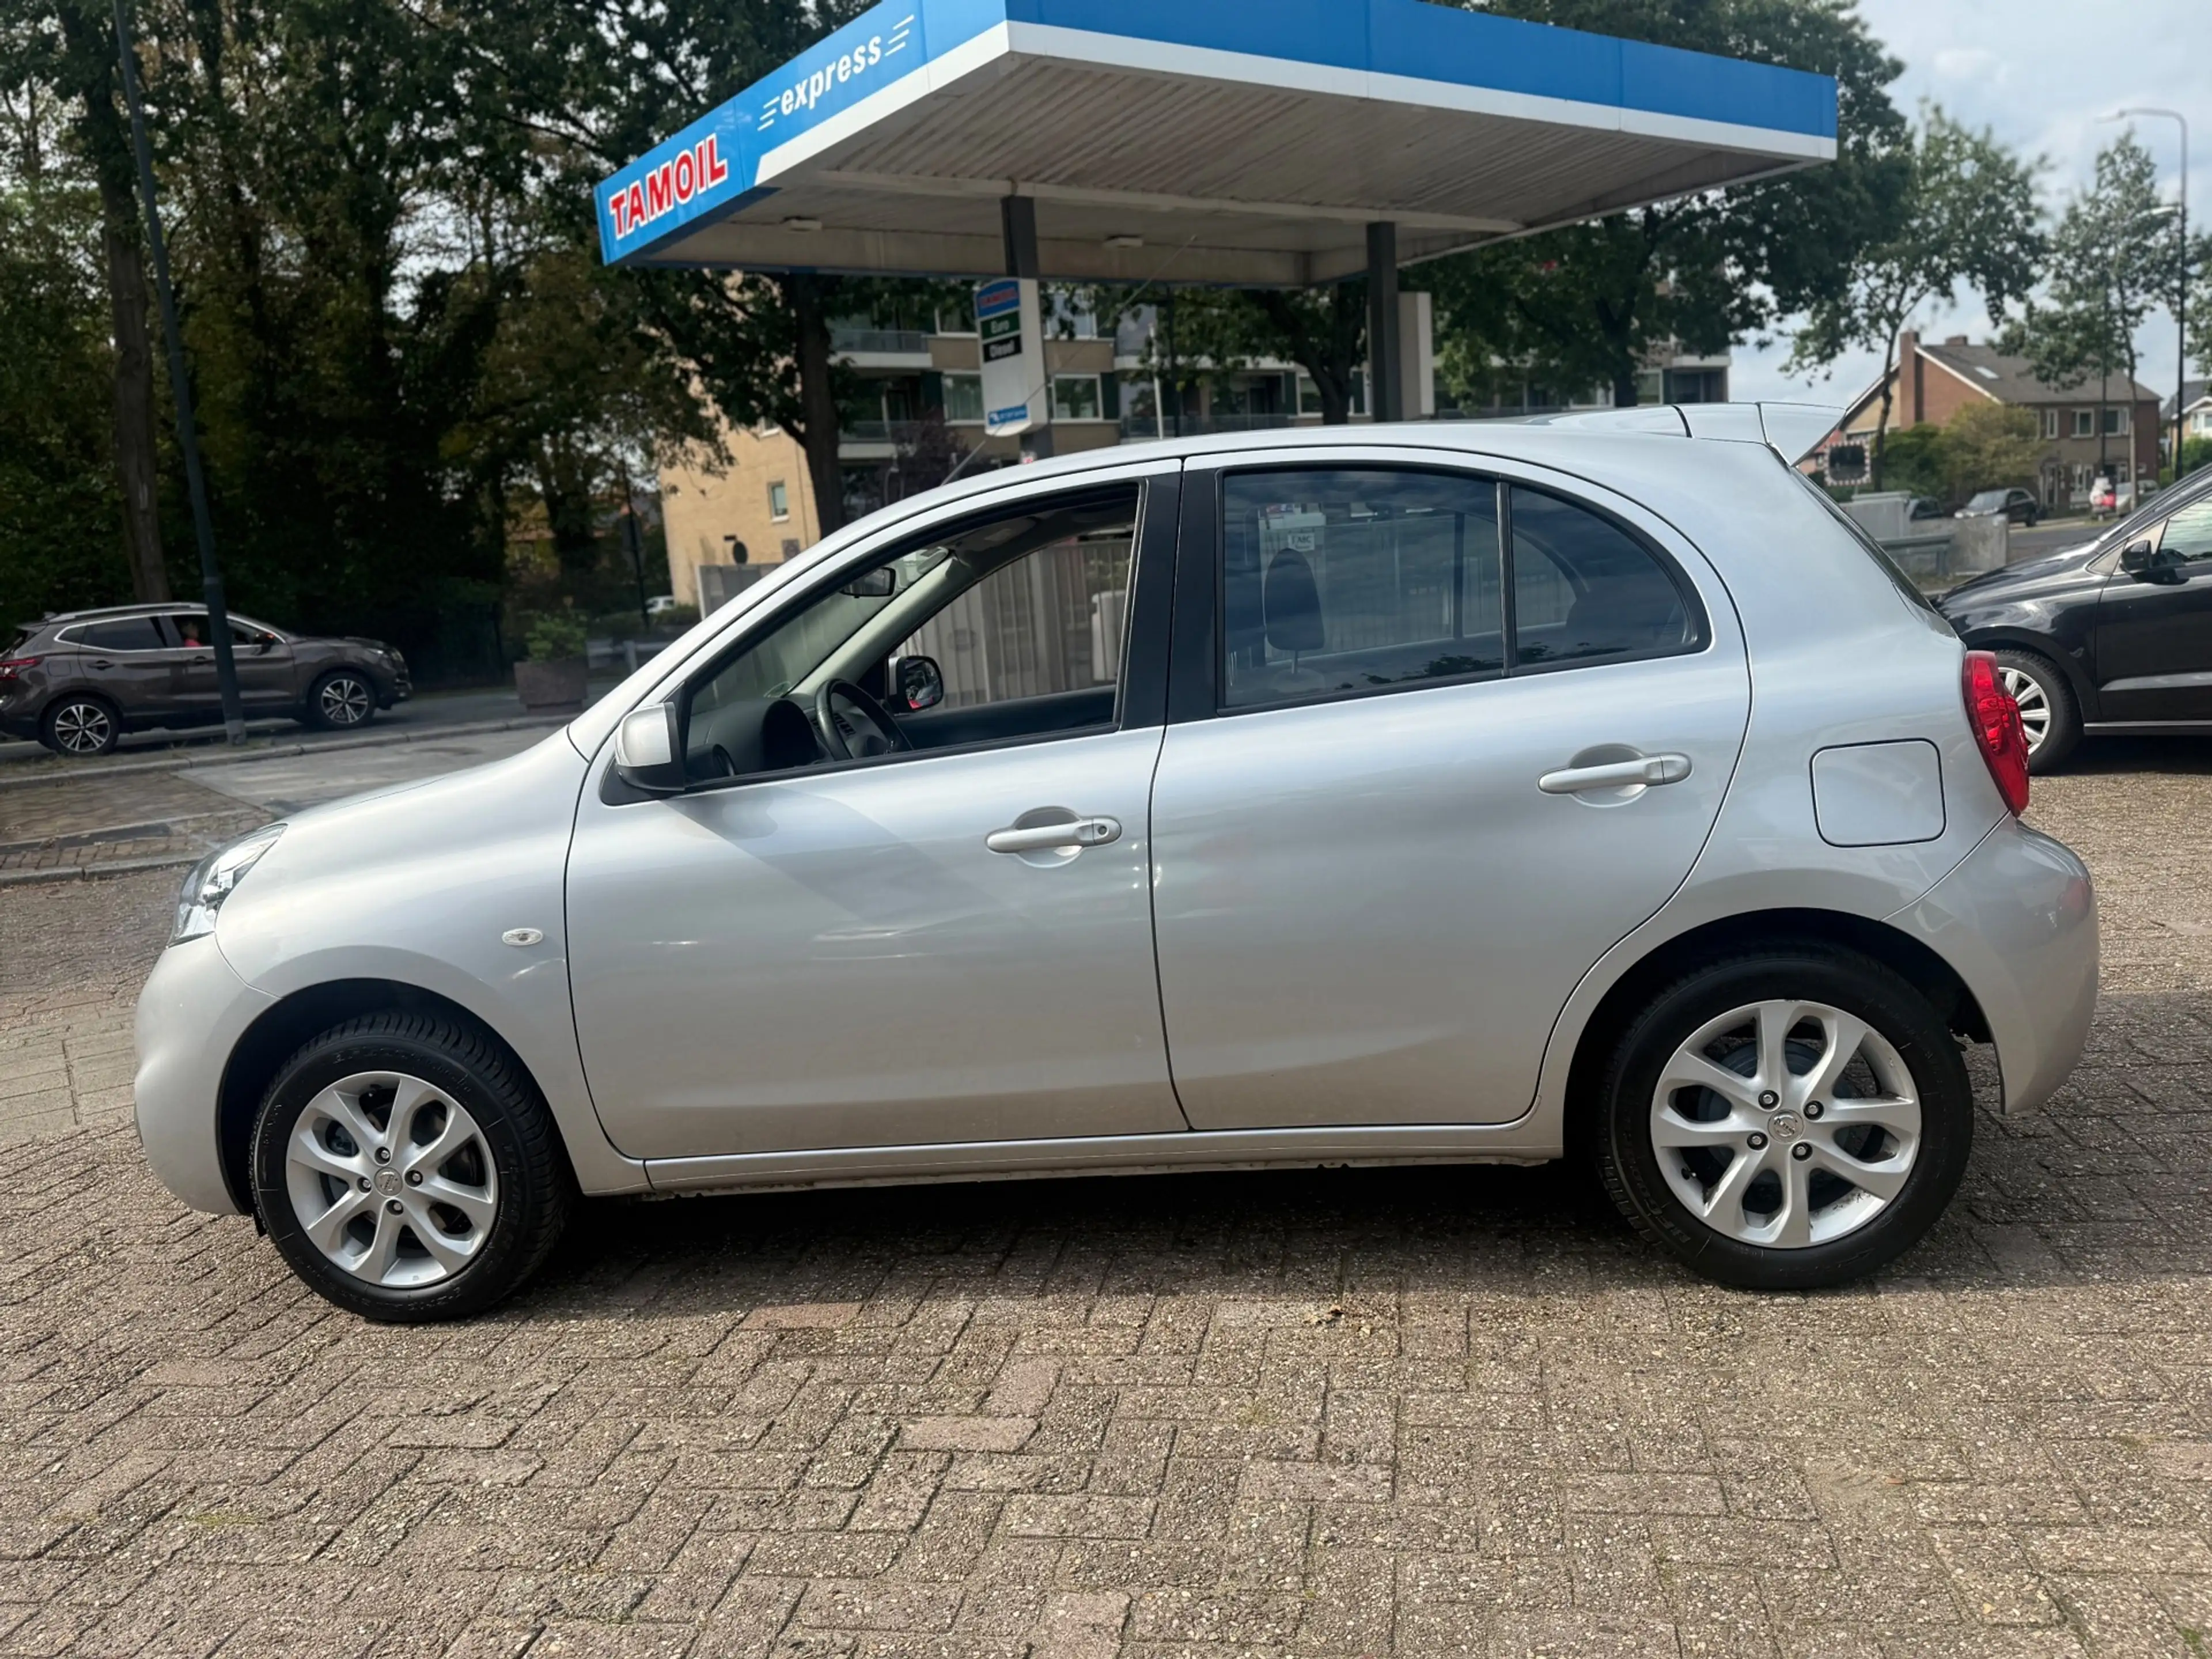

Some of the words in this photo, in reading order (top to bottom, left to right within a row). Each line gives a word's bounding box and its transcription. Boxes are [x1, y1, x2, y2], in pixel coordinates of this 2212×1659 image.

[781, 36, 881, 115] express
[609, 132, 728, 240] TAMOIL
[990, 320, 1010, 334] Euro
